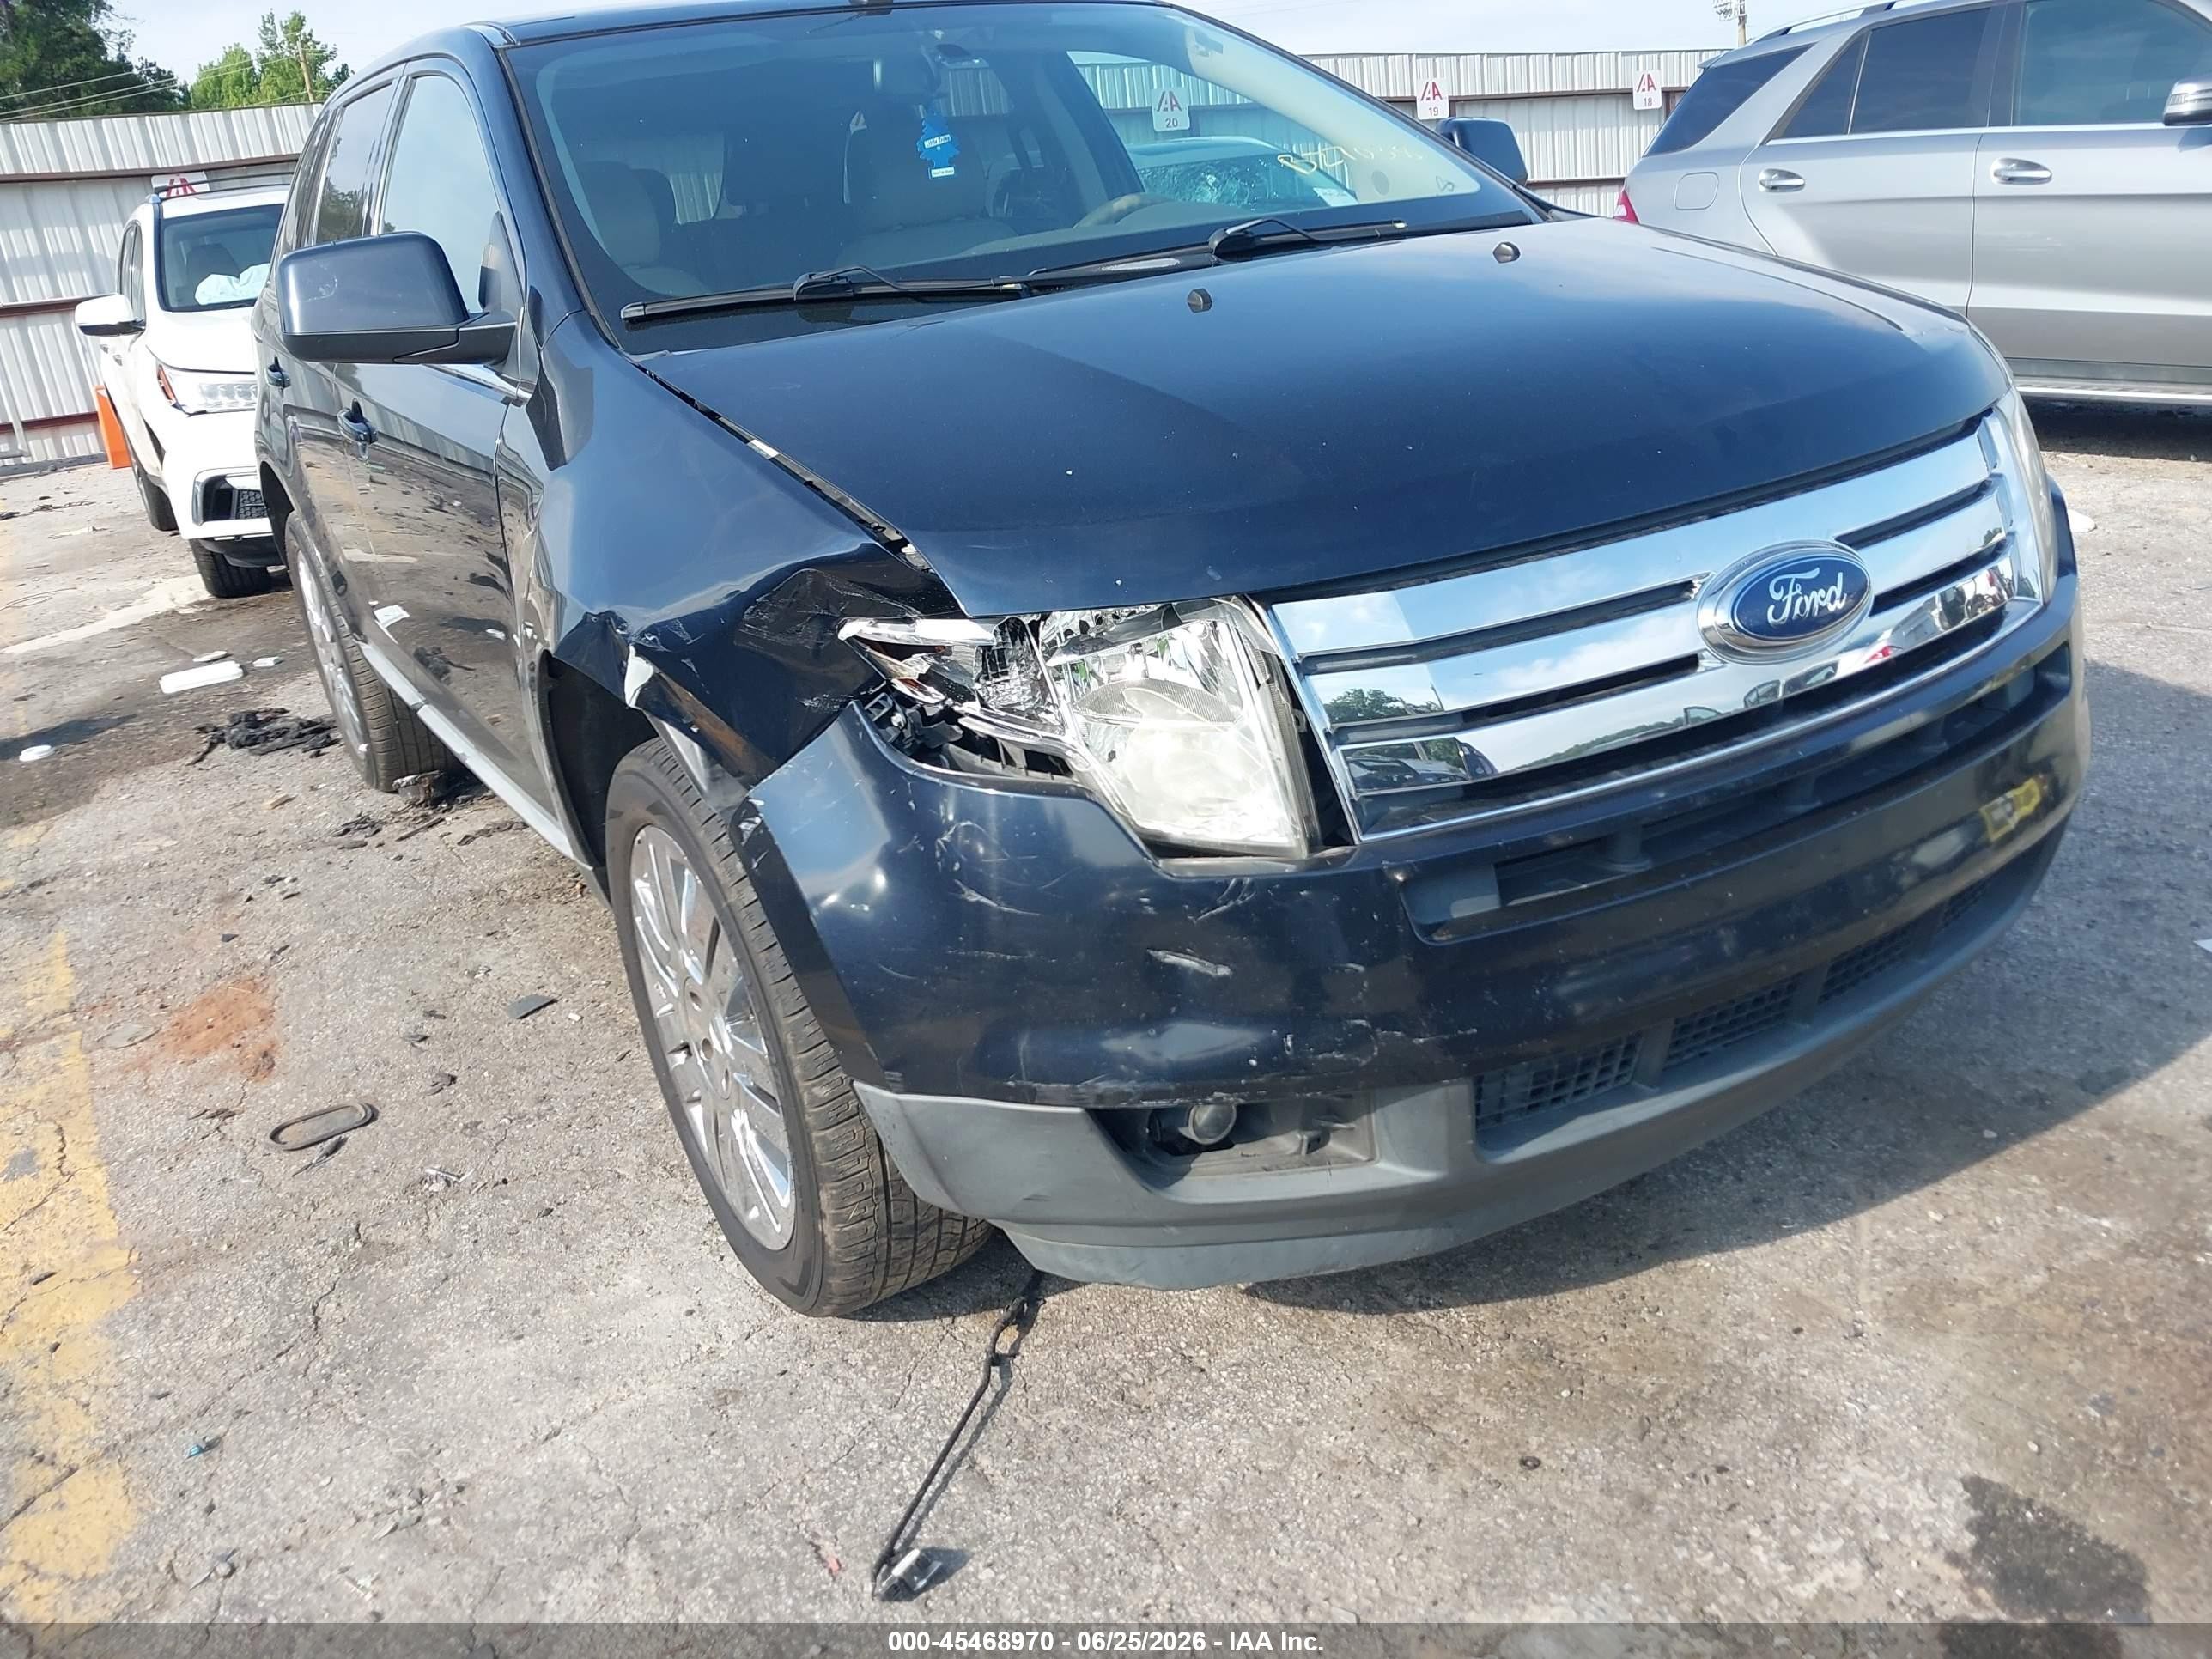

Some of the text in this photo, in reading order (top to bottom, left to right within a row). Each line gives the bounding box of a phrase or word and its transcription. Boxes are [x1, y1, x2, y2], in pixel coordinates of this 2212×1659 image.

[1644, 97, 1653, 106] 18
[1428, 106, 1439, 117] 19
[1165, 118, 1178, 128] 20
[1767, 568, 1846, 626] Ford
